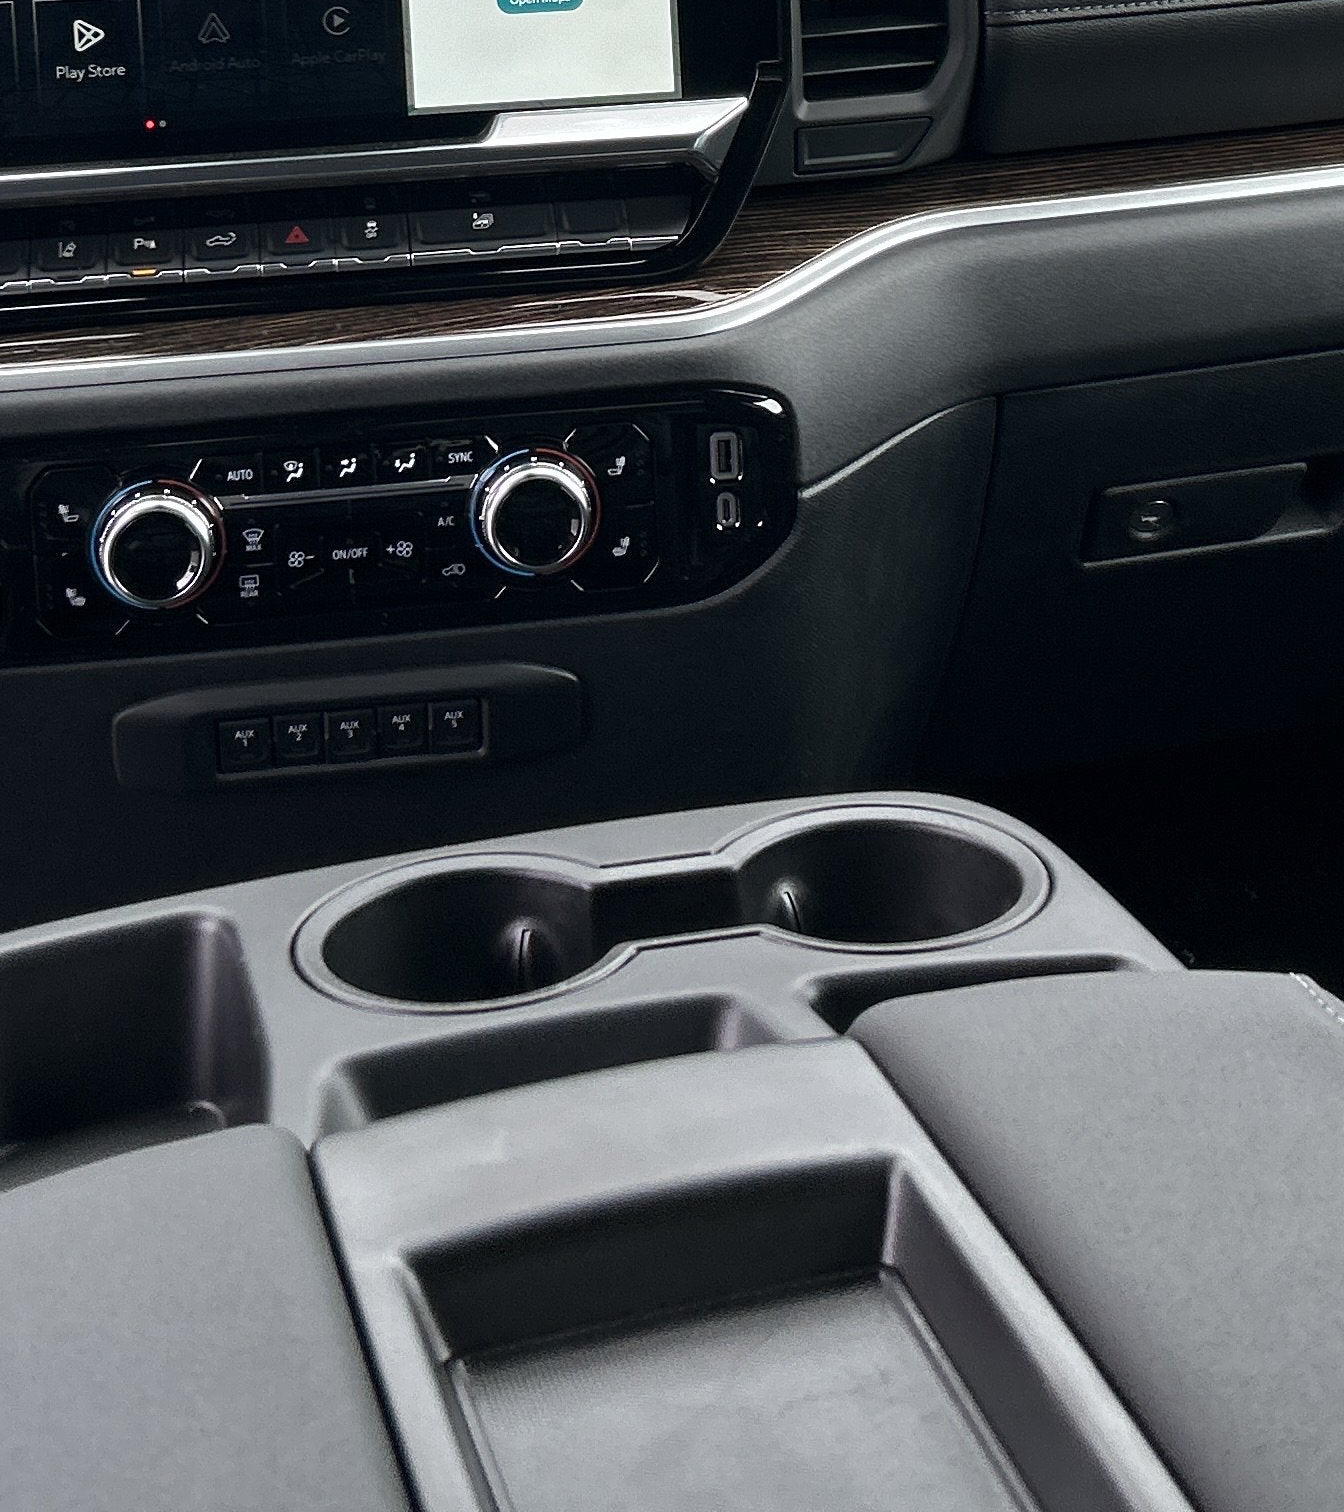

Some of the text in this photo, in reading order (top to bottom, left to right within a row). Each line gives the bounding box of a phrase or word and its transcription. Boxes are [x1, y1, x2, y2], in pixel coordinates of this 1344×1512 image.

[56, 64, 127, 82] Play Store
[448, 451, 475, 465] SYNC
[227, 469, 254, 482] AUTO
[437, 515, 456, 527] A/C
[332, 547, 369, 561] ON/OFF
[391, 714, 412, 724] AUX
[443, 710, 465, 720] AUX
[287, 723, 308, 734] AUX
[339, 720, 360, 731] AUX
[234, 729, 255, 740] AUX
